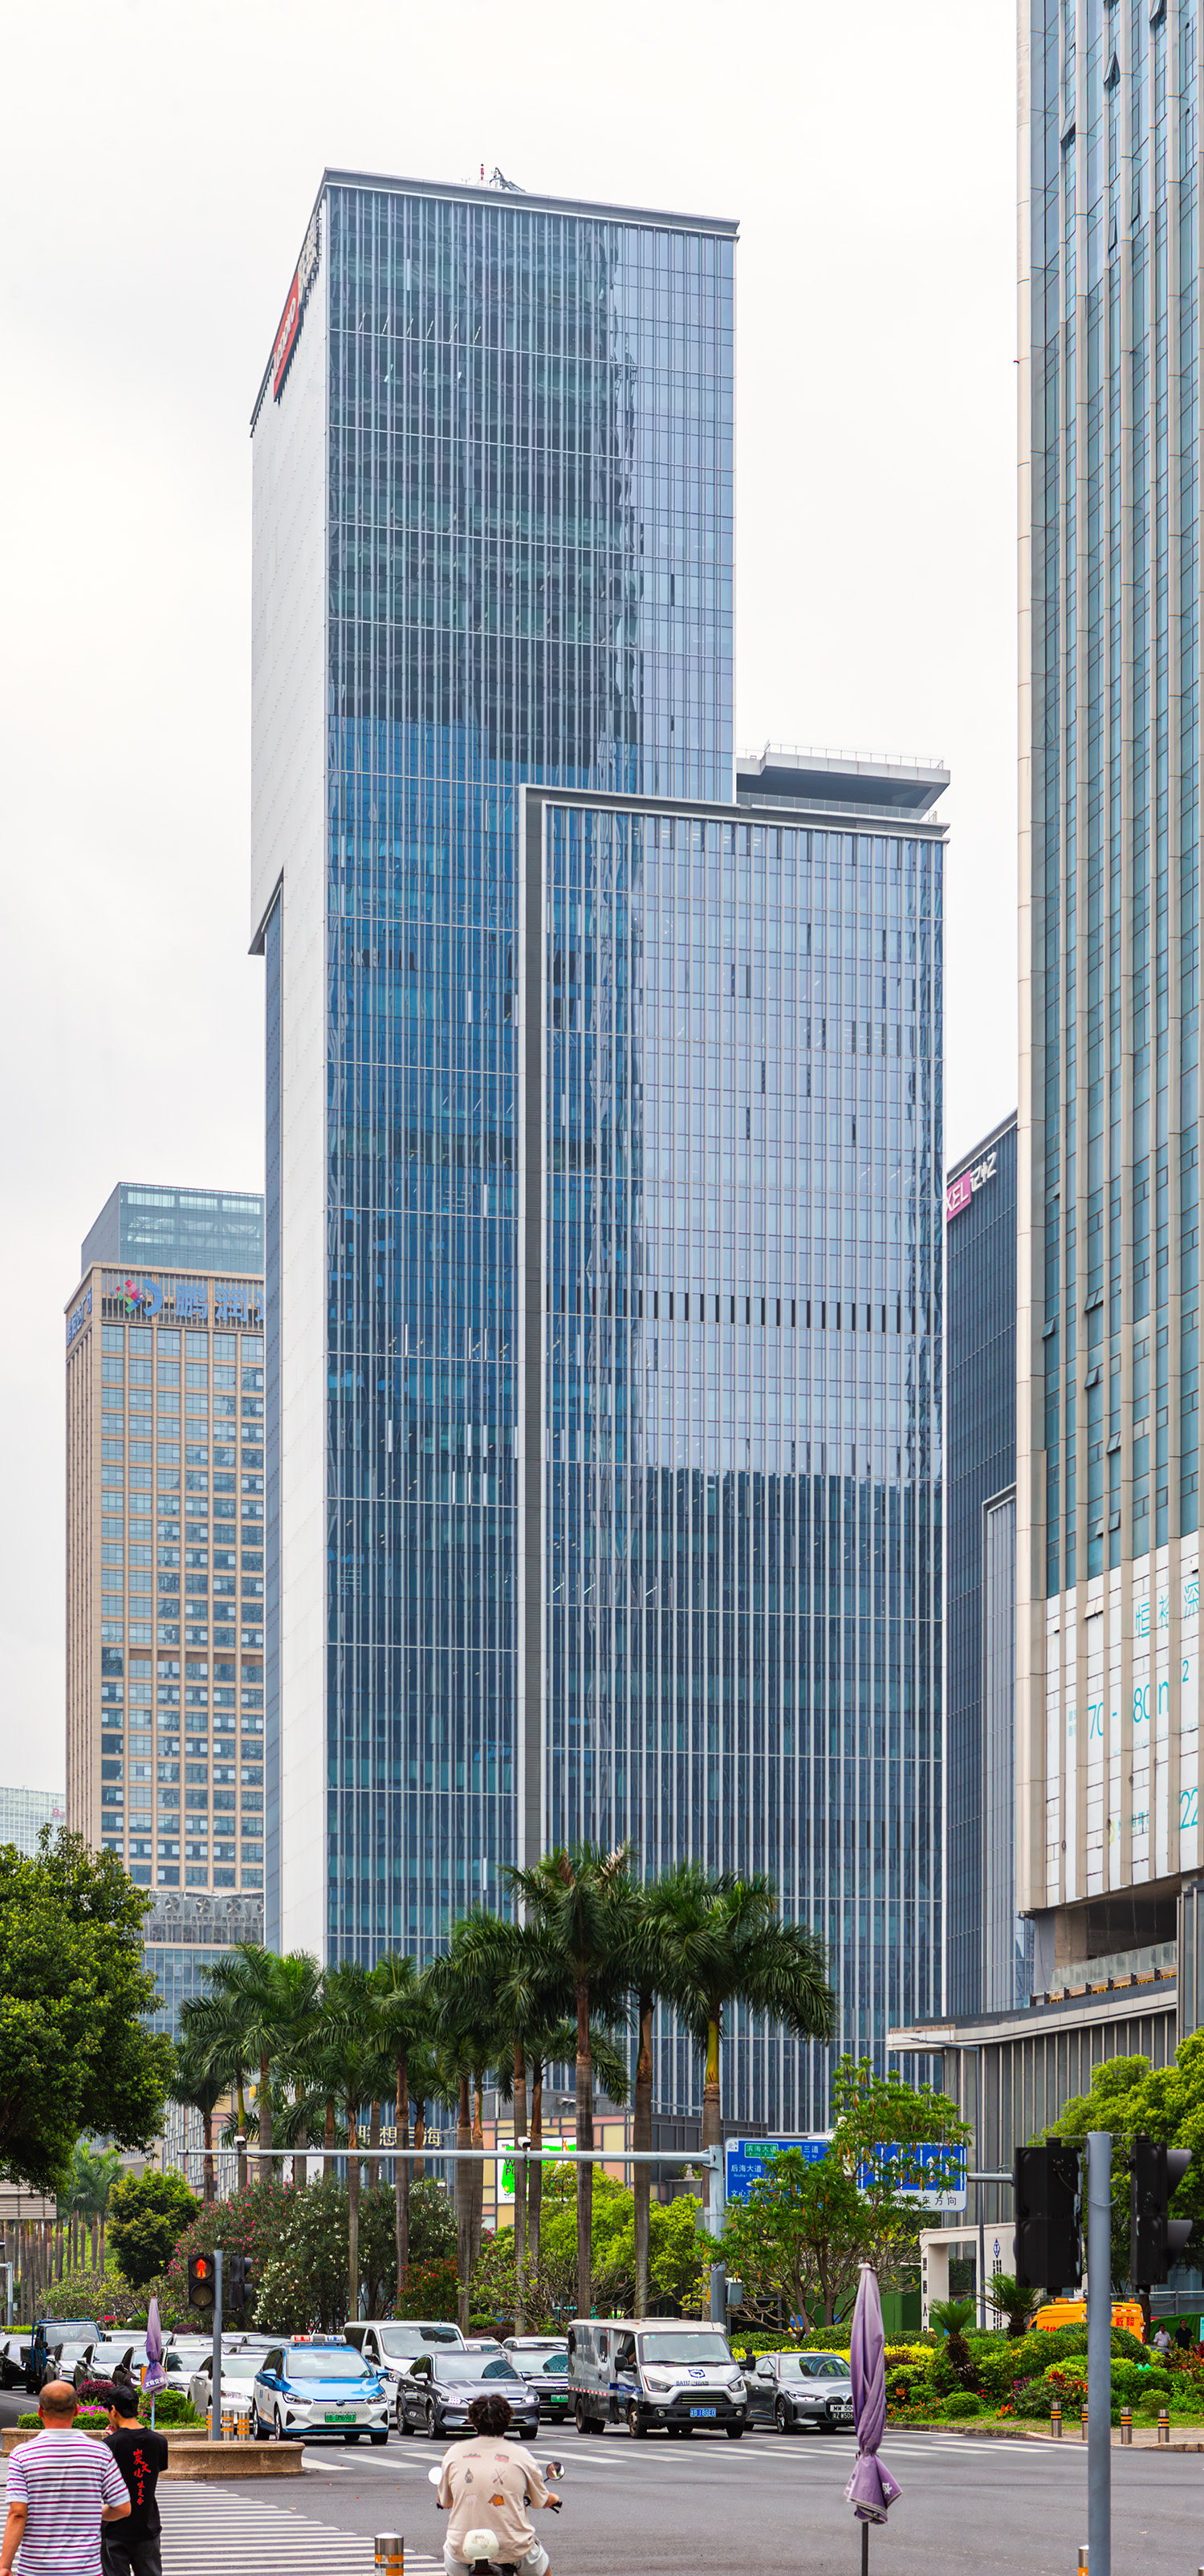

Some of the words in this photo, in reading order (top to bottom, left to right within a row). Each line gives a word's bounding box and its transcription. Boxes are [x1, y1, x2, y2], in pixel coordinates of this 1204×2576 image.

[746, 2144, 777, 2153] 滨海大道
[787, 2145, 819, 2153] 三道
[730, 2164, 762, 2173] 后海大道
[731, 2189, 751, 2198] 文心
